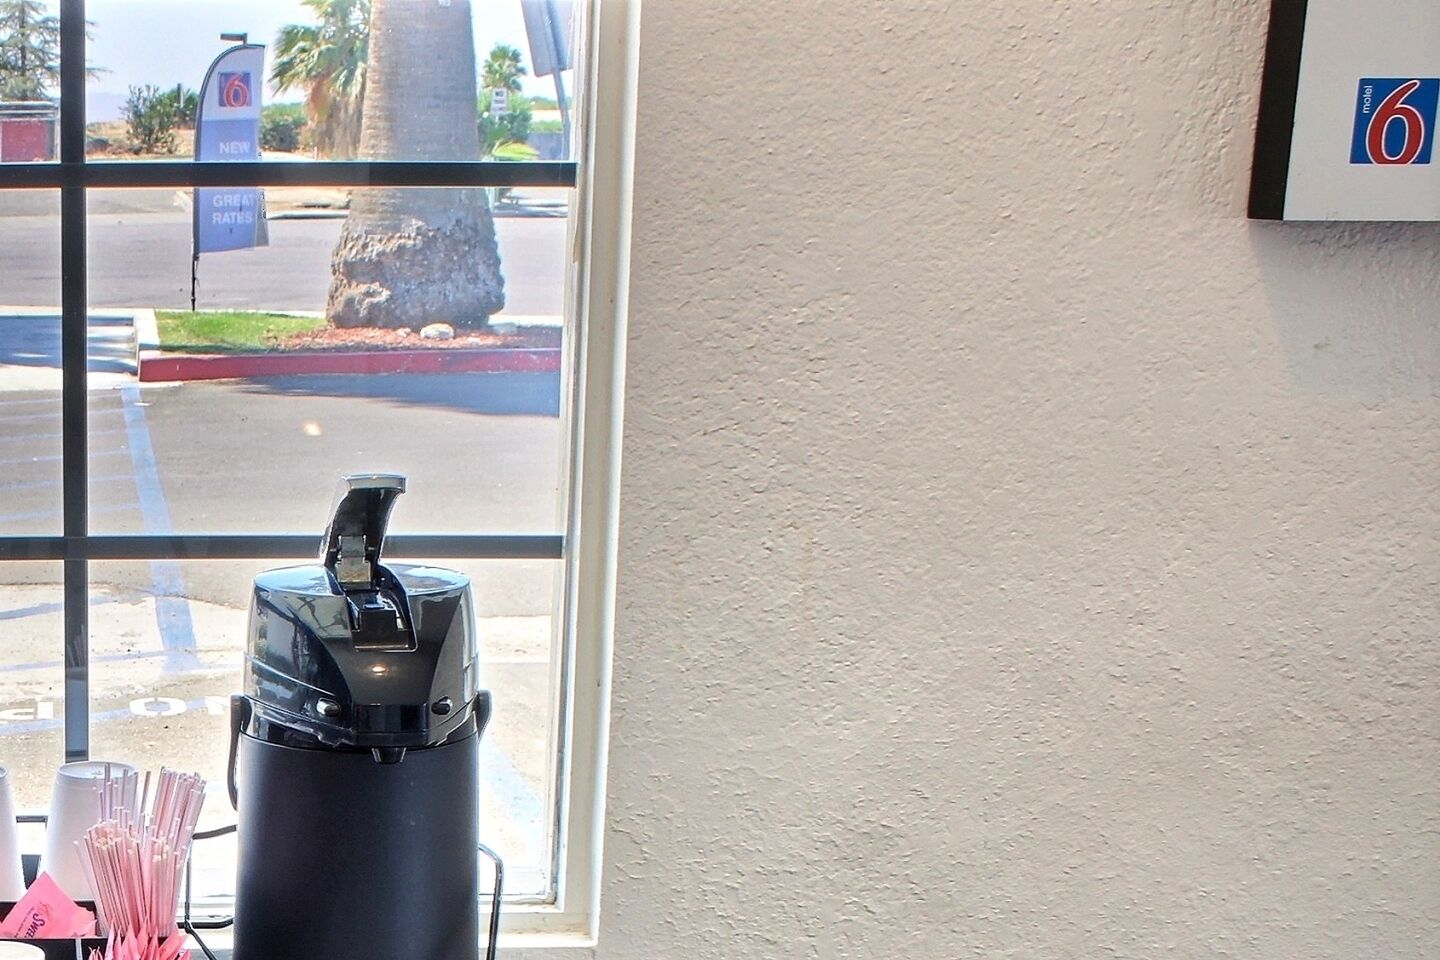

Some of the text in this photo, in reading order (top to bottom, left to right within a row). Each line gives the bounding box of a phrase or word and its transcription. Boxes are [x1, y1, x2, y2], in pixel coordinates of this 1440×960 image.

[224, 74, 249, 108] 6
[1362, 79, 1425, 166] motel 6
[219, 141, 251, 154] NEW
[212, 194, 255, 208] GREAT
[212, 212, 253, 225] RATES
